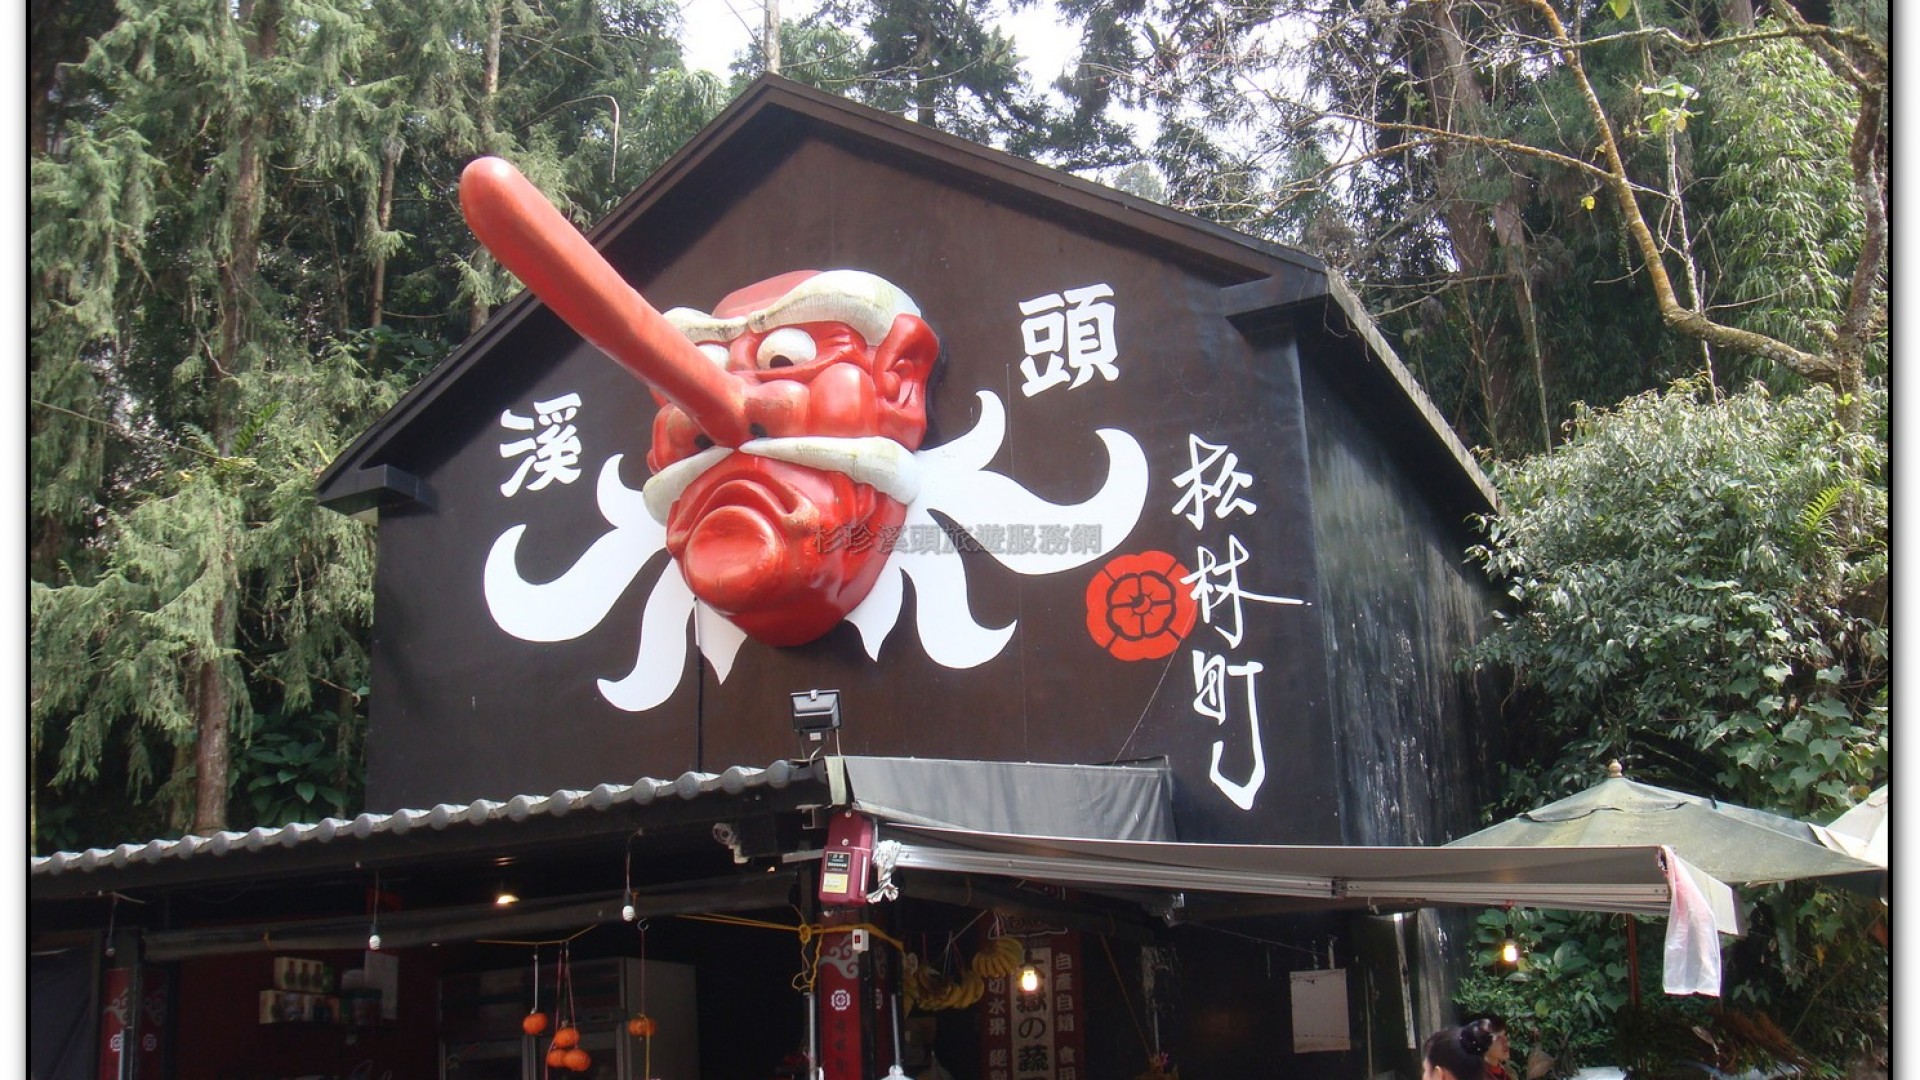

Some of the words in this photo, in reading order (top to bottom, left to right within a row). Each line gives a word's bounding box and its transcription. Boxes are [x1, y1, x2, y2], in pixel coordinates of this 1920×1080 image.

[1018, 283, 1120, 398] 頭
[499, 391, 583, 498] 溪
[1171, 432, 1304, 812] 松林町
